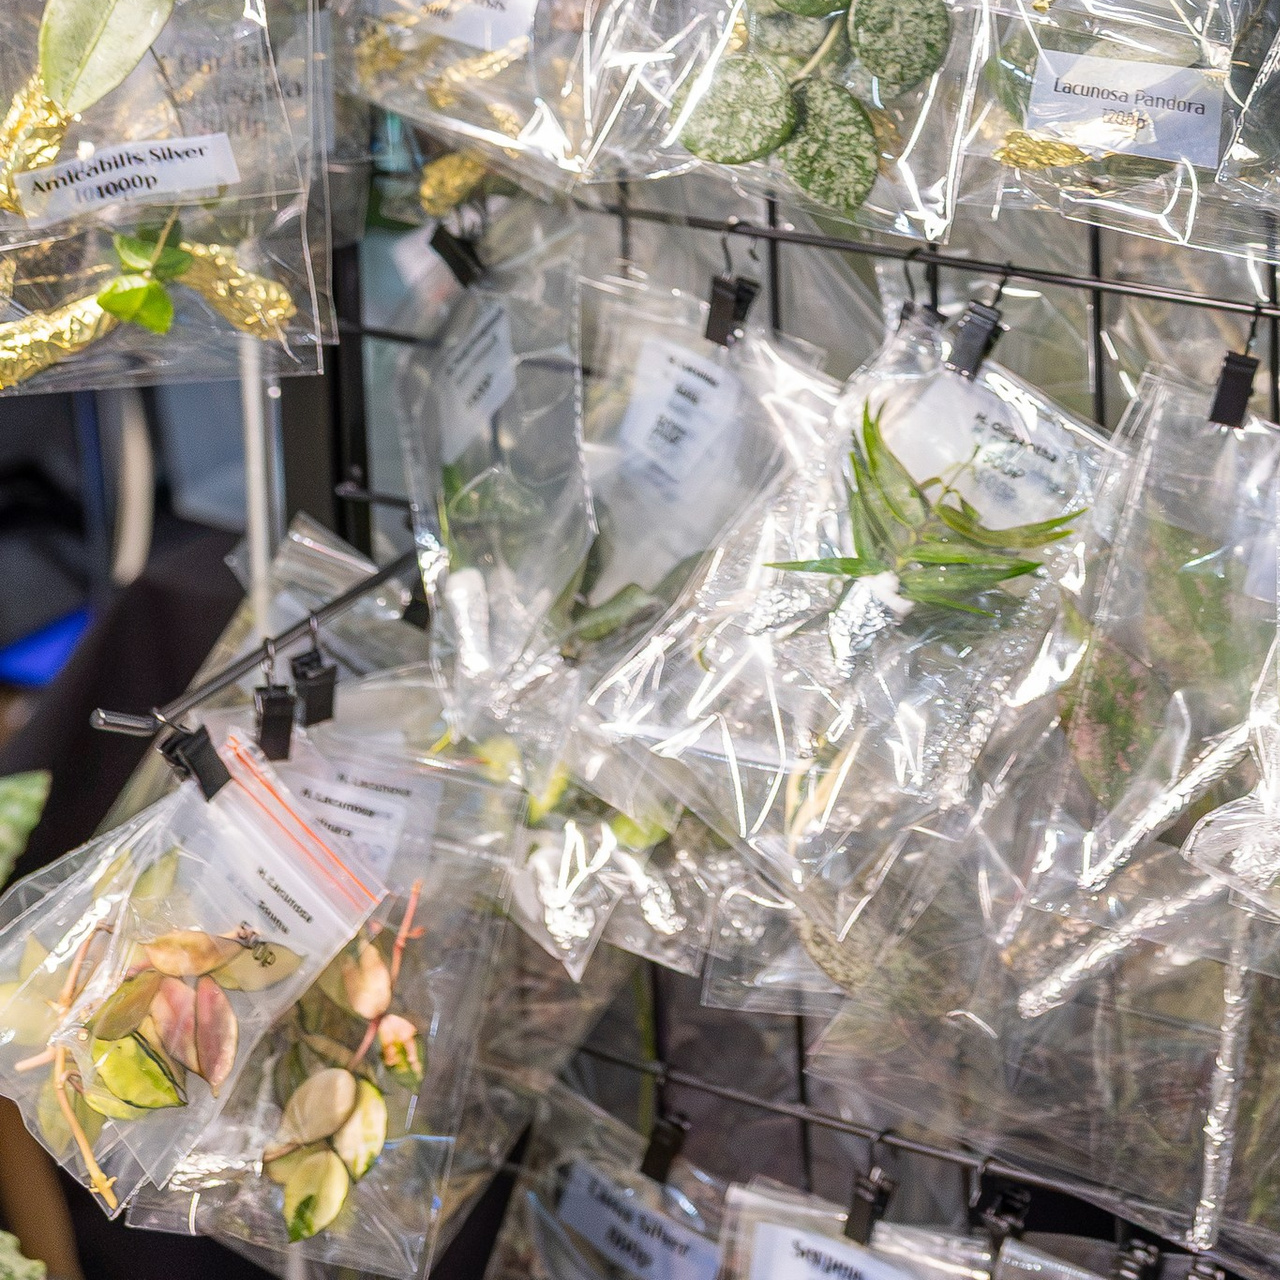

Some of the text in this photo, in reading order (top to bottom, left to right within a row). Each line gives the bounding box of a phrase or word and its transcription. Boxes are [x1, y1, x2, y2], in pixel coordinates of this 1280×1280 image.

[1053, 76, 1206, 117] Lacunosa Pandora
[31, 143, 208, 196] Amicabilis Silver
